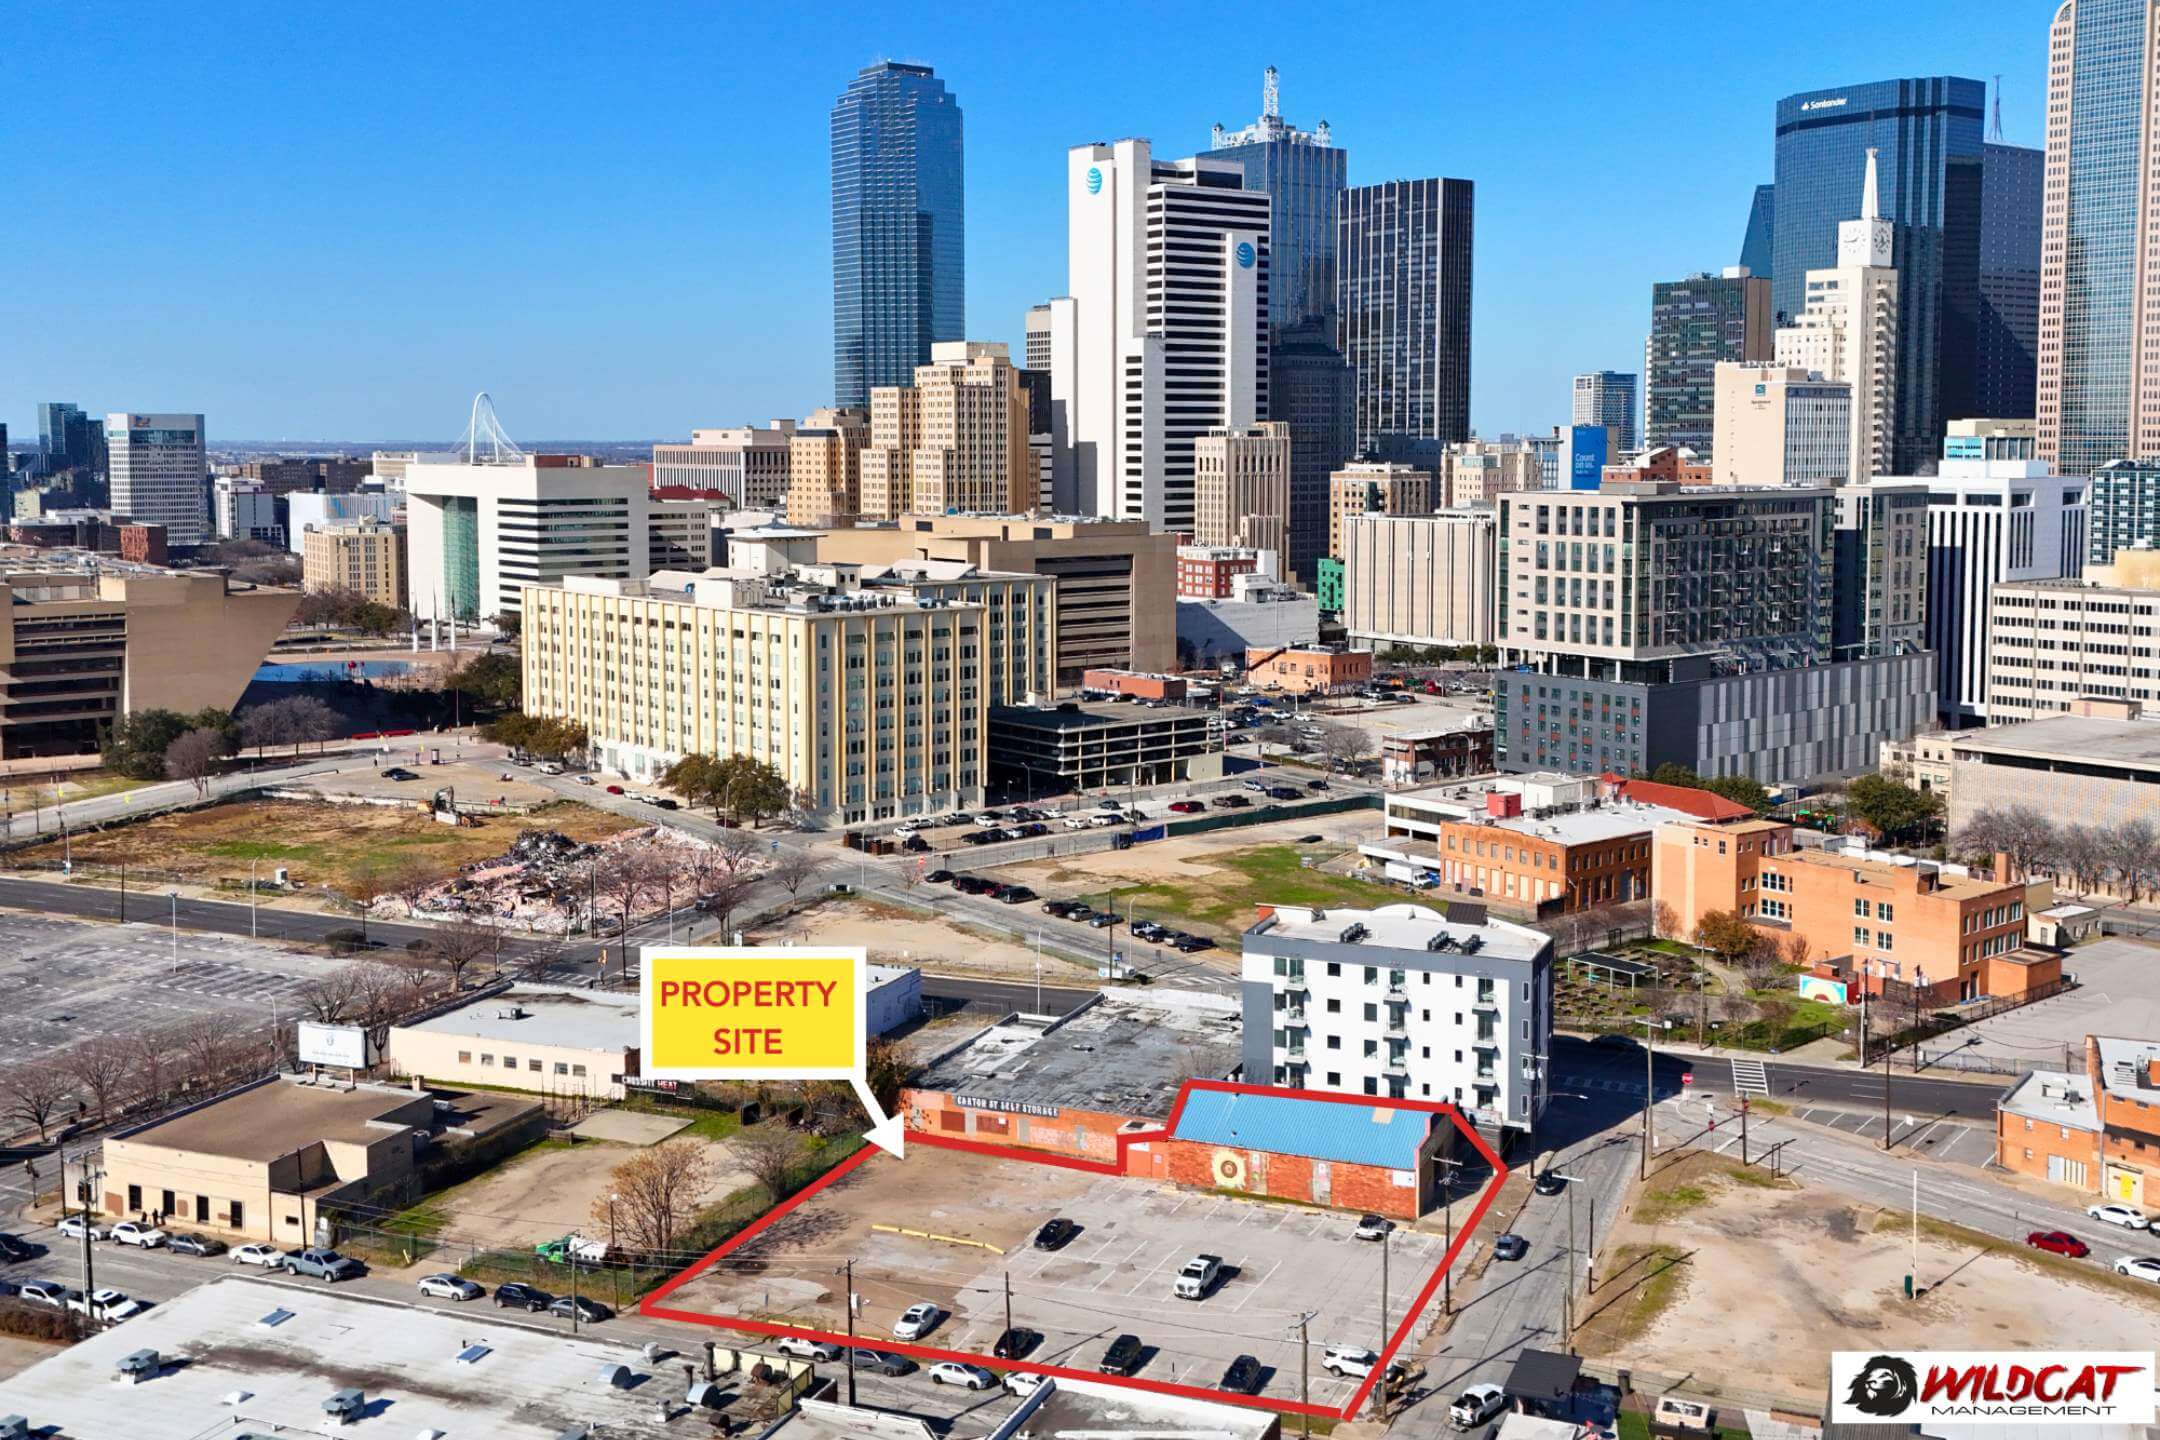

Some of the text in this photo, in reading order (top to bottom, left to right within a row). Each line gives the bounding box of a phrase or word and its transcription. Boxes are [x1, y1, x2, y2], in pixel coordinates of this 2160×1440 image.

[957, 1095, 1058, 1117] CANTON ST SELF STORAGE
